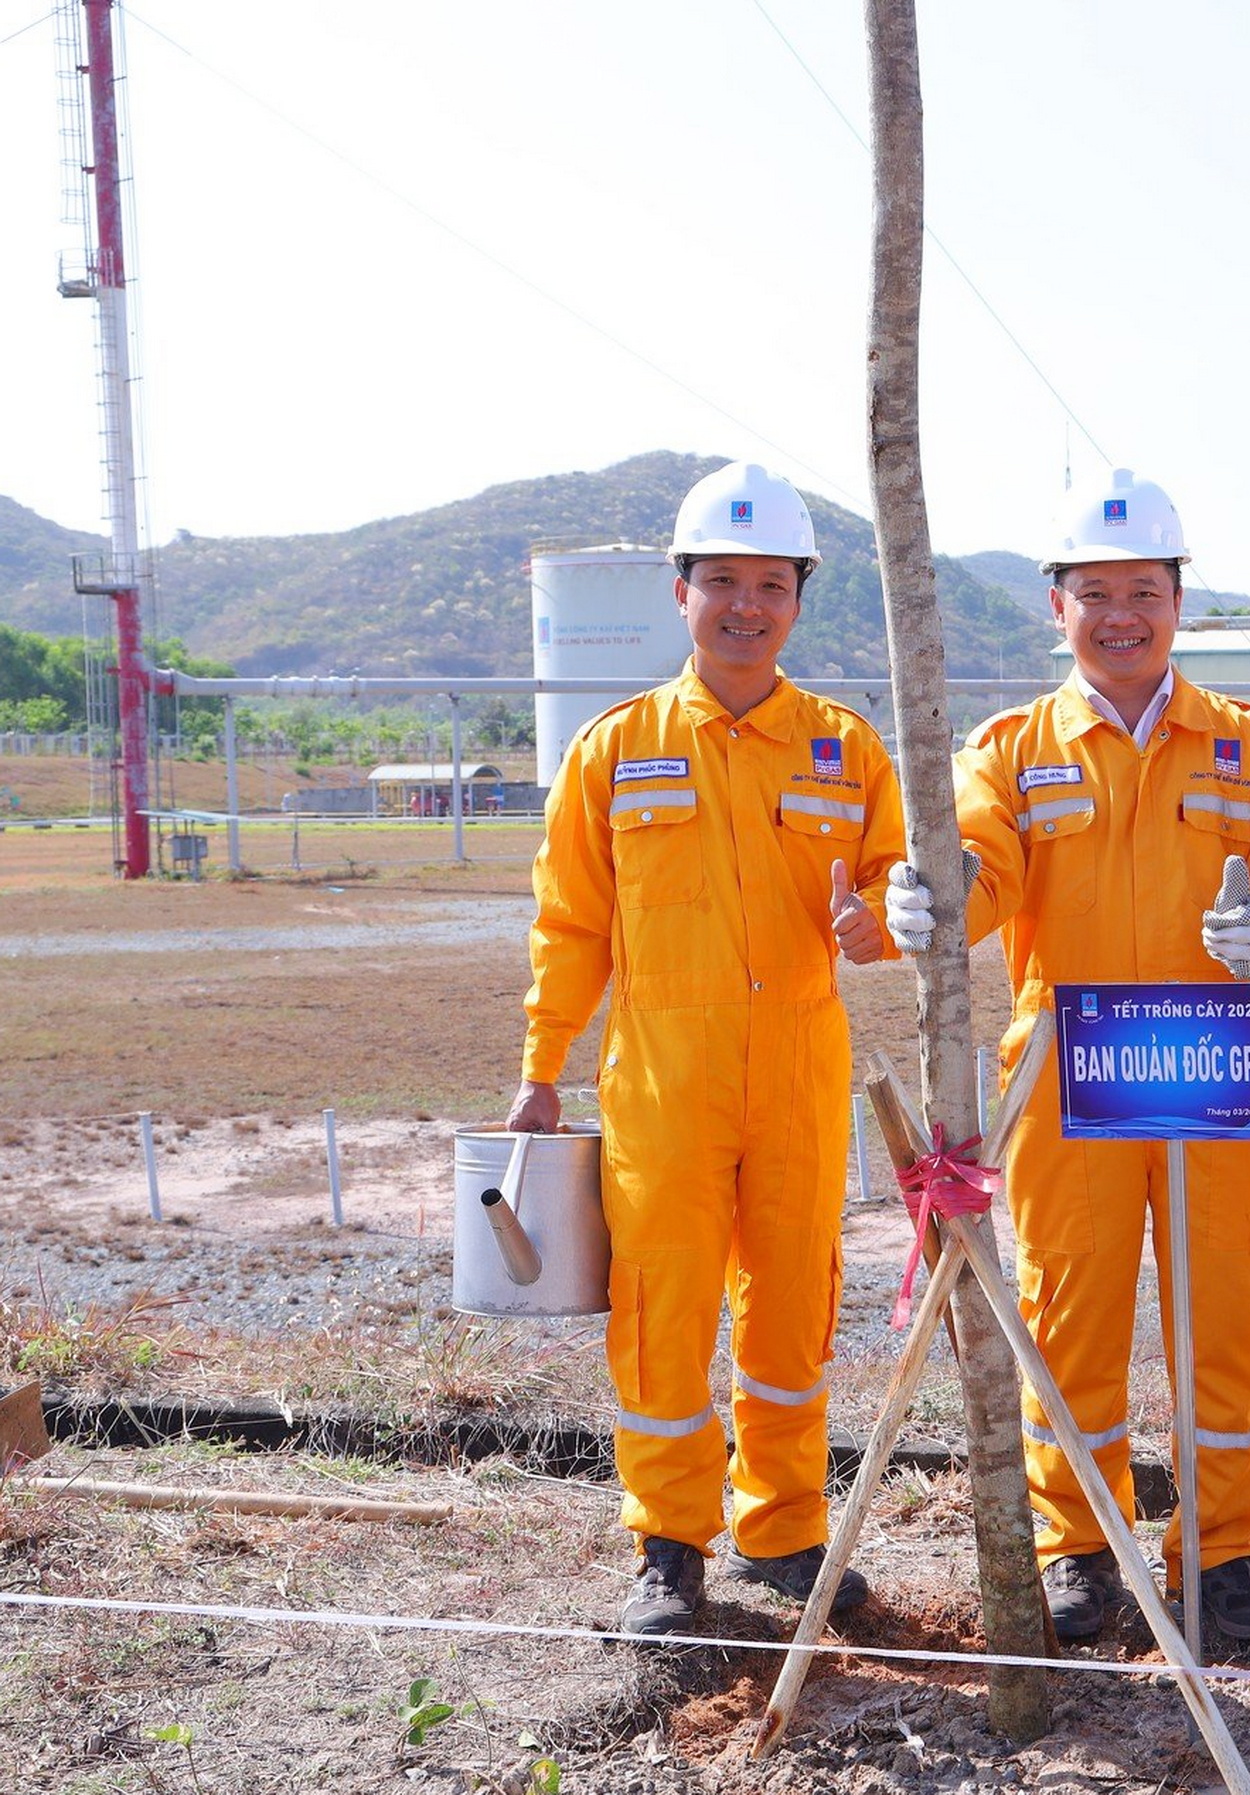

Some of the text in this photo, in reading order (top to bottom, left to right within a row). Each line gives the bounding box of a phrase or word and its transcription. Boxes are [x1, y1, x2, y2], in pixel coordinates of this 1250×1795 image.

[1112, 998, 1139, 1018] TẾT
[1143, 998, 1192, 1018] TRỒNG
[1196, 1000, 1225, 1018] CÂY
[1073, 1045, 1116, 1082] BAN
[1120, 1033, 1178, 1083] QUẢN
[1183, 1033, 1224, 1082] ĐỐC
[1206, 1107, 1231, 1118] Tháng
